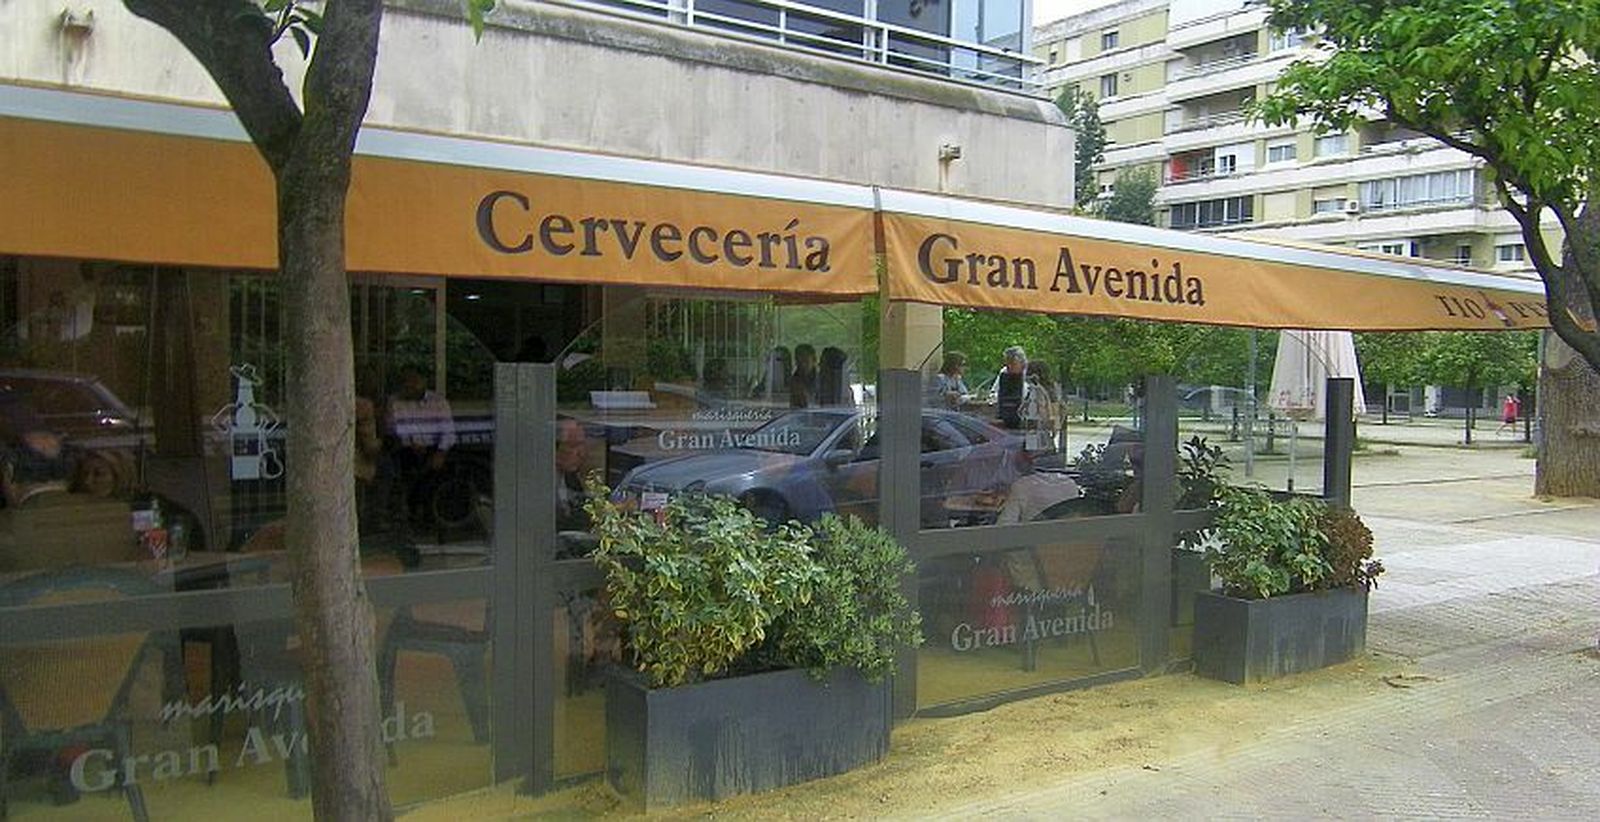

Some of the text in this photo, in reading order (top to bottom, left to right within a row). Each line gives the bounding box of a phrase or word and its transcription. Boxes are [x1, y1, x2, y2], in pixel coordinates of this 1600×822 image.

[475, 189, 832, 273] Cervecería
[917, 233, 1206, 307] Gran Avenida
[658, 426, 801, 450] Gran Avenida
[951, 602, 1114, 652] Gran Avenida
[69, 700, 435, 793] Gran Avda
